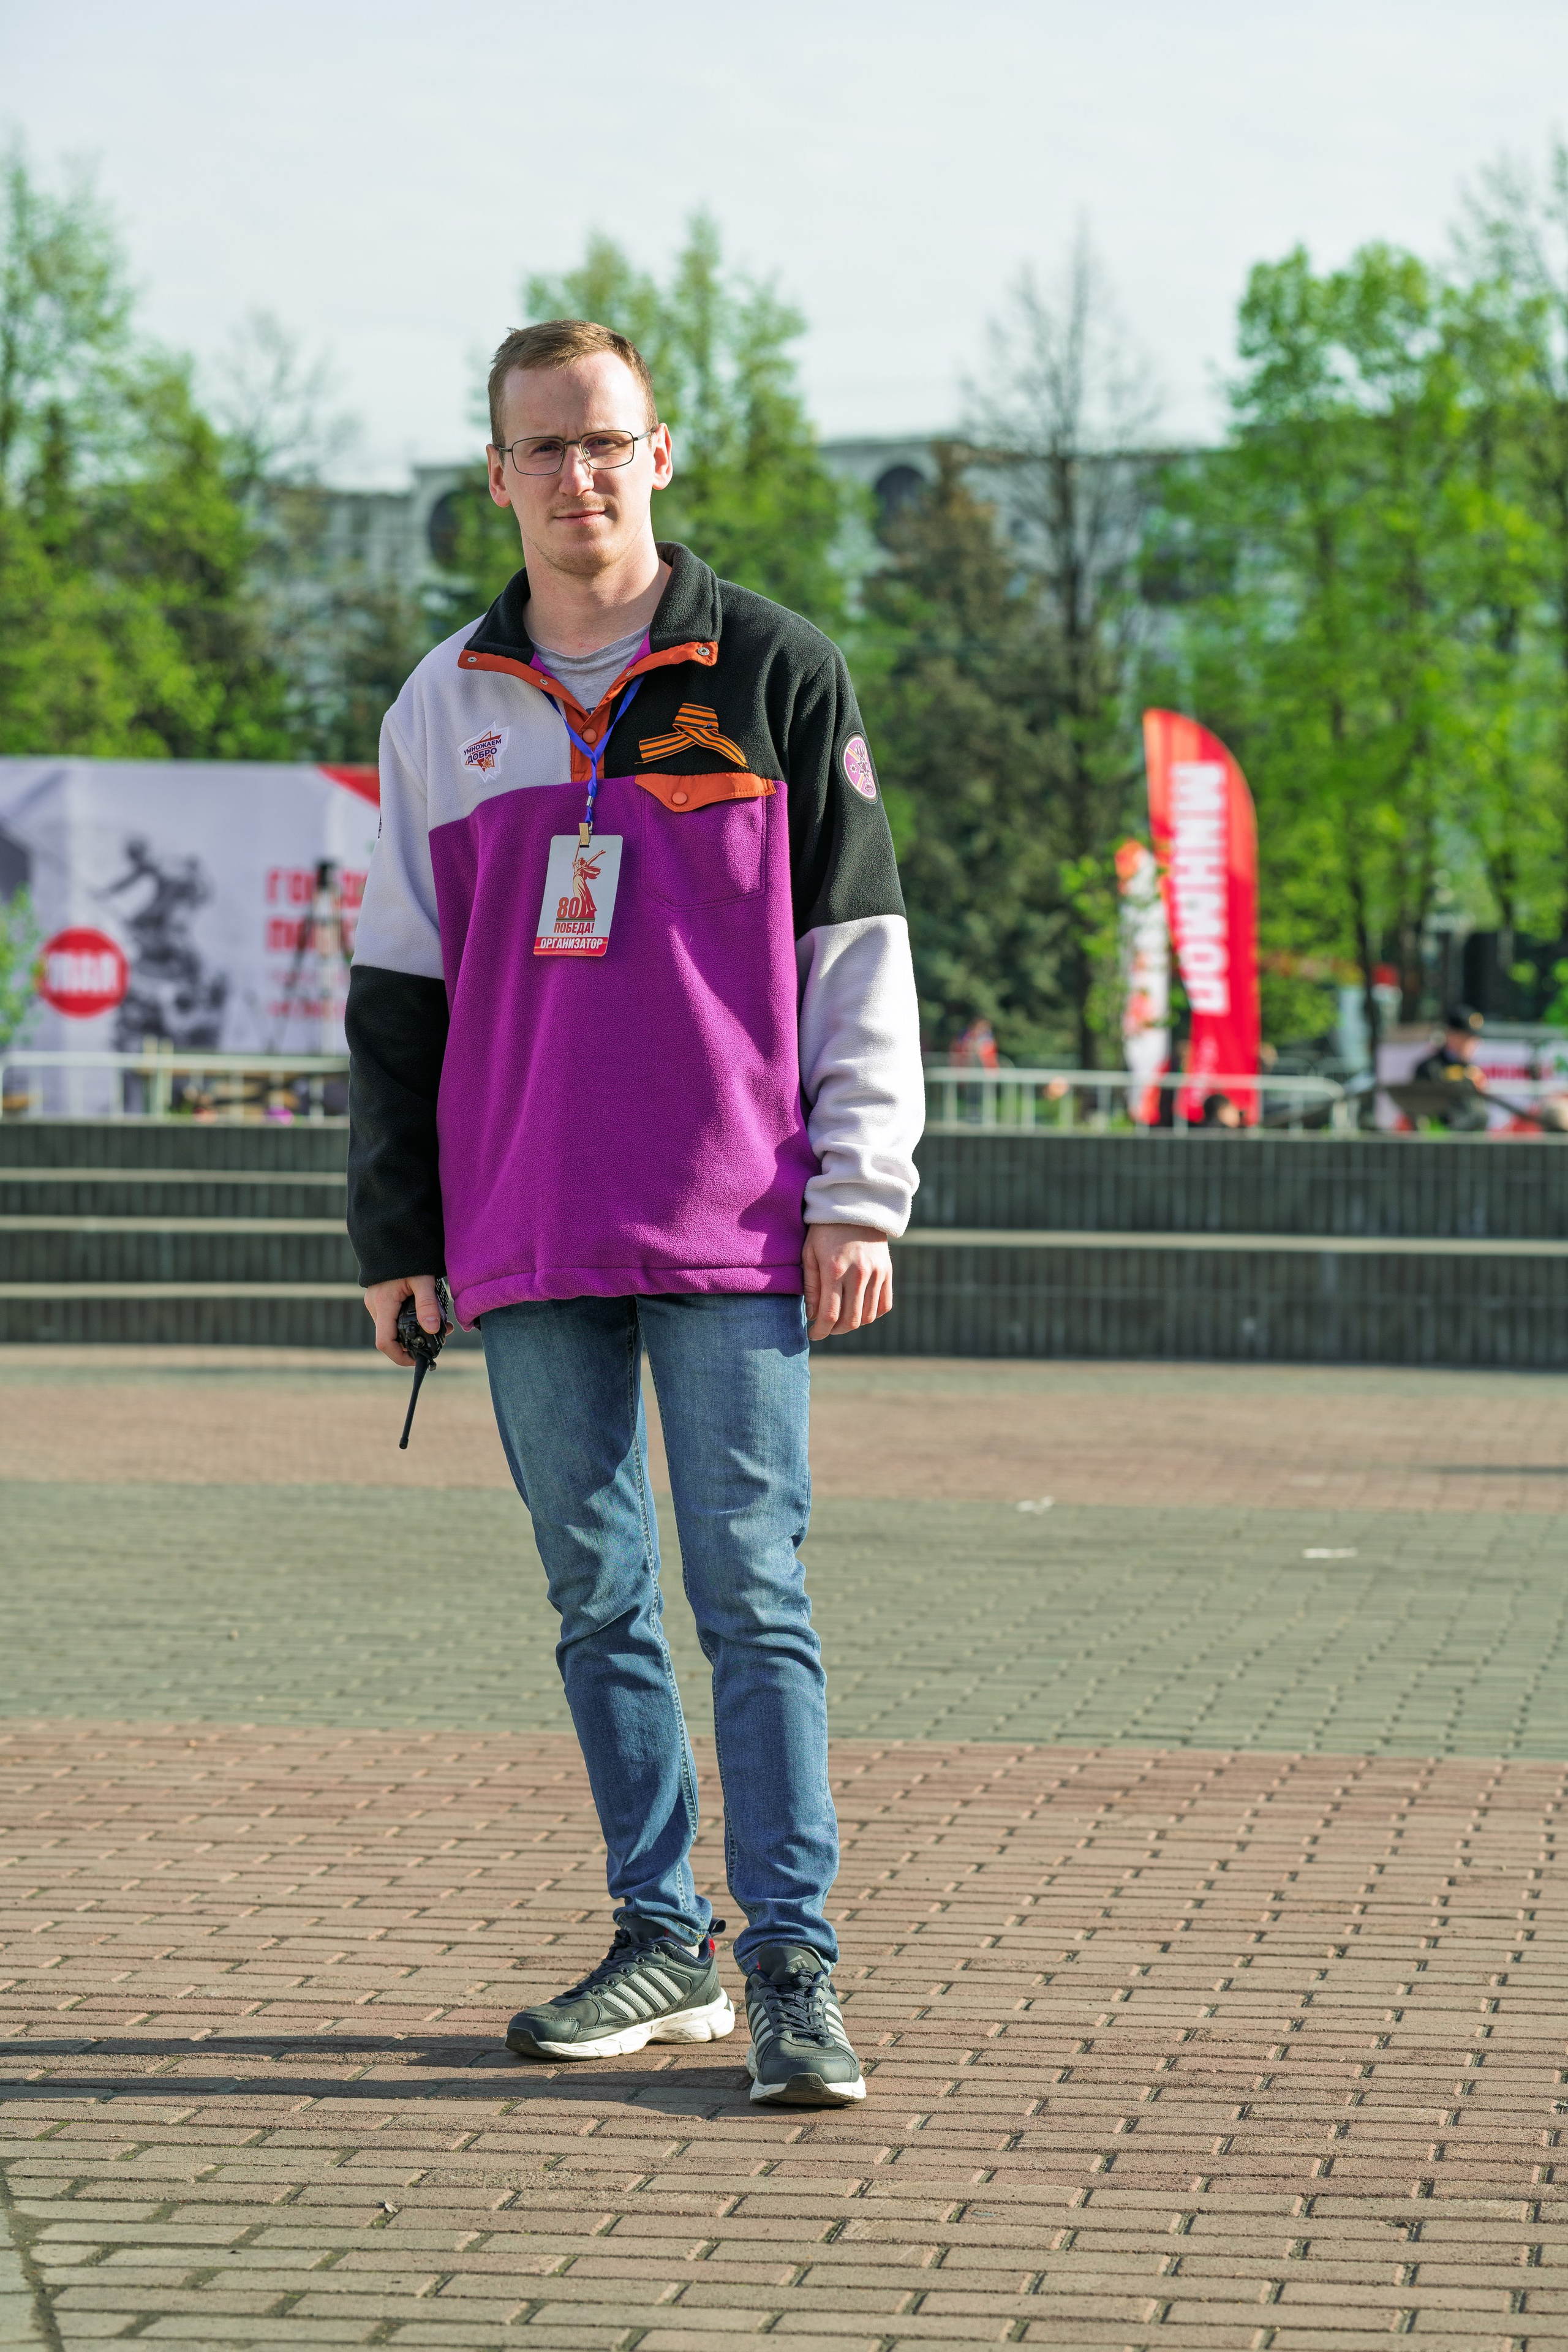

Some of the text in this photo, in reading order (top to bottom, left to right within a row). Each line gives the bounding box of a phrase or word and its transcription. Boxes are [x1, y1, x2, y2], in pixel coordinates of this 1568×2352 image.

[464, 739, 501, 755] УМНОЖАЕМ
[468, 747, 497, 764] ДОБРО
[557, 897, 581, 918] 80
[554, 922, 594, 935] ПОБЕДА!
[540, 938, 603, 949] ОРГАНИЗАТОР
